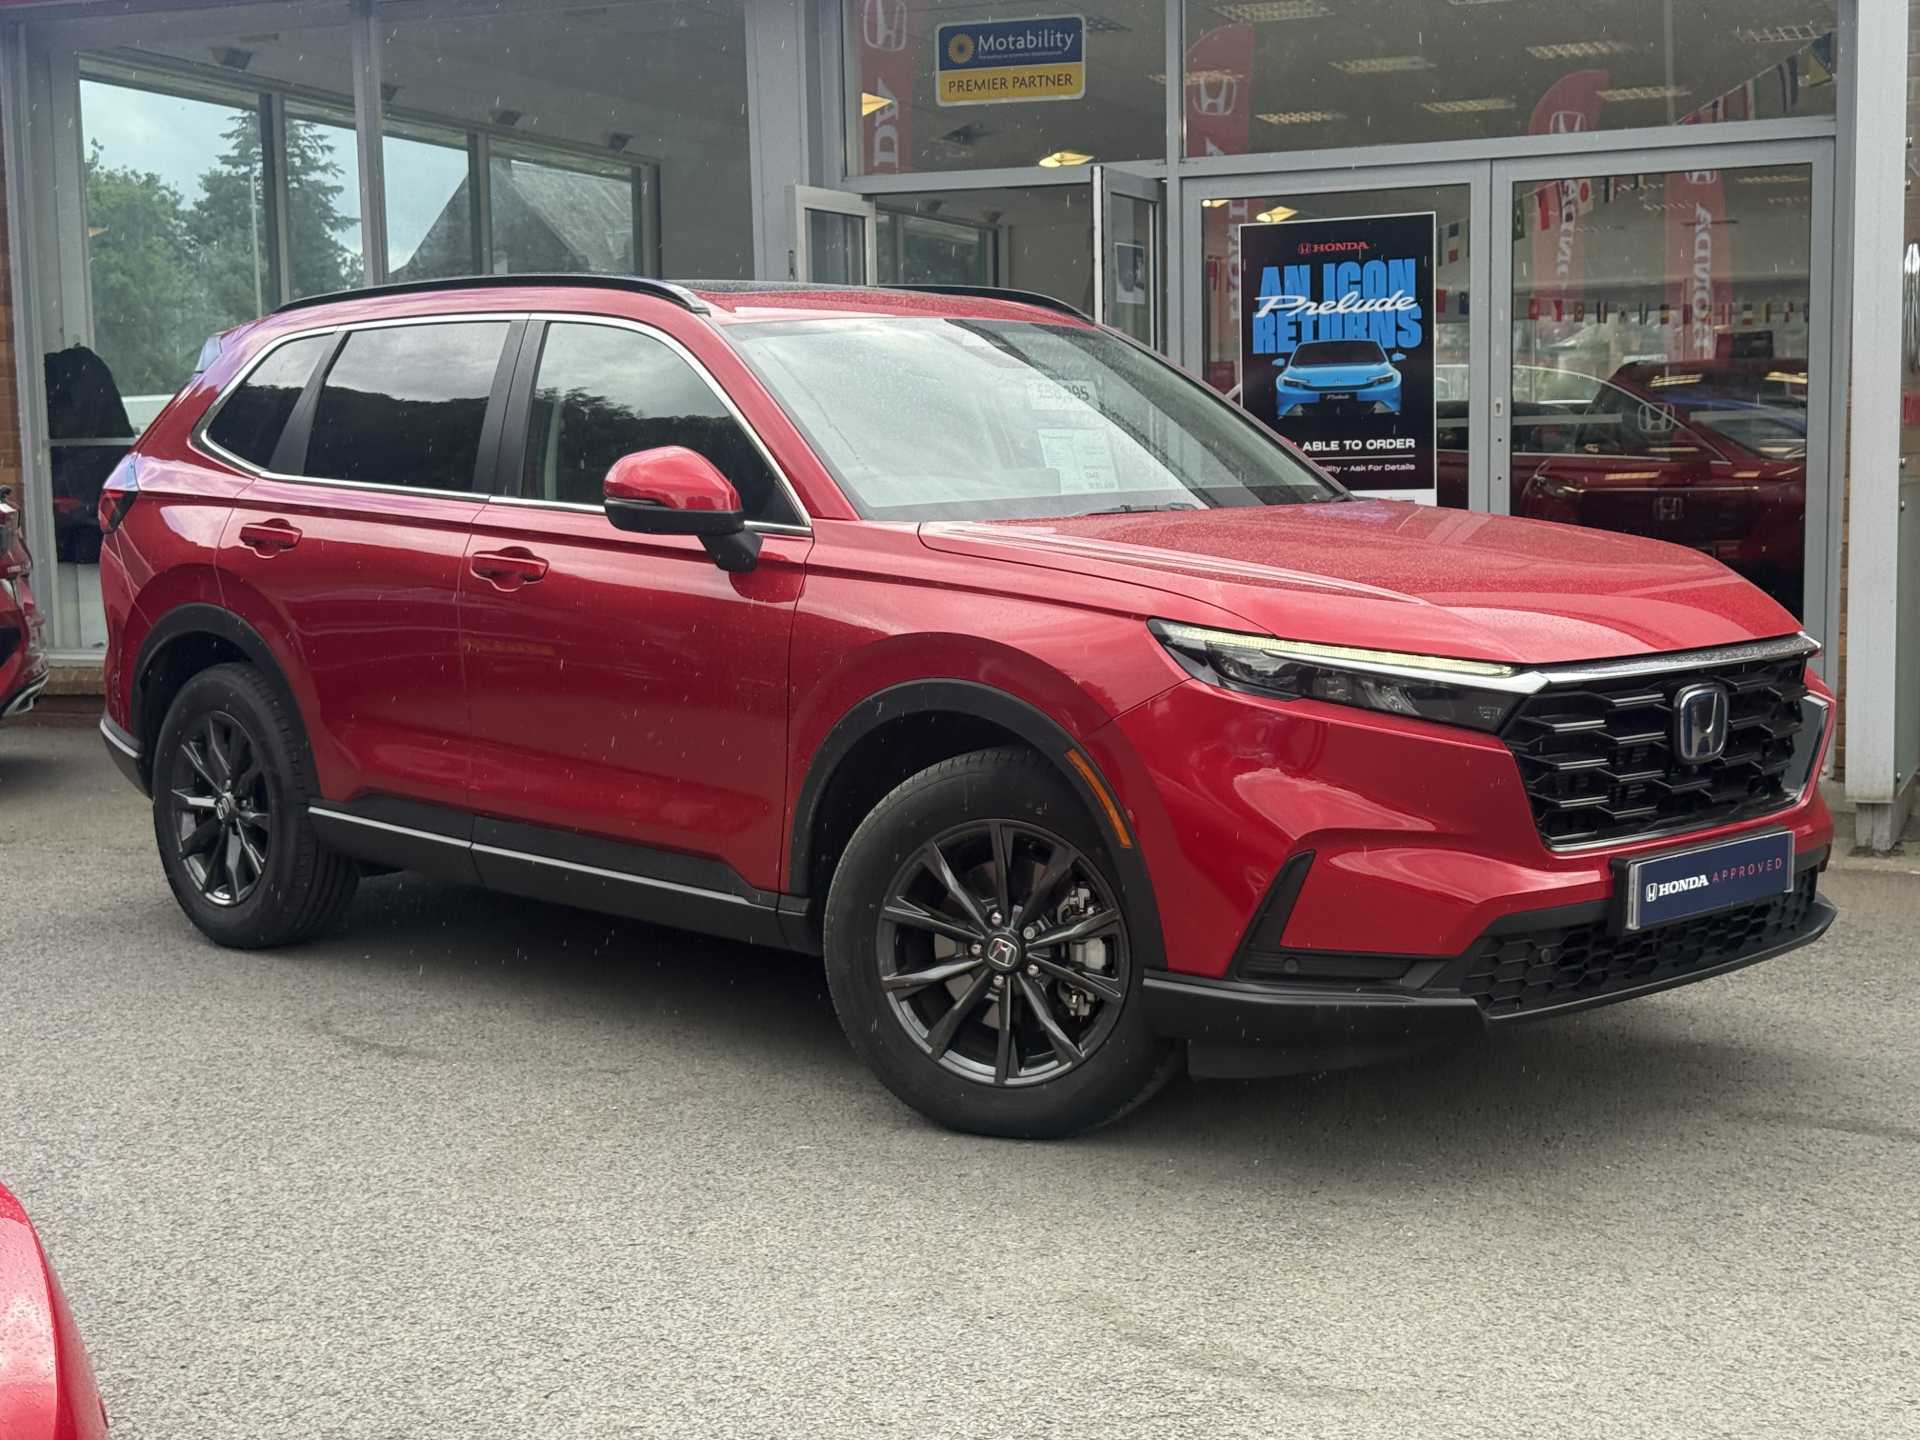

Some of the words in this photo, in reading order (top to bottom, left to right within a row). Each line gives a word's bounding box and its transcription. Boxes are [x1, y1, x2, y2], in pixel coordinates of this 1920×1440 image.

[978, 28, 1074, 52] Motability
[948, 77, 1009, 93] PREMIER
[1012, 73, 1073, 89] PARTNER
[1313, 241, 1370, 253] HONDA
[1258, 264, 1311, 310] AN
[1323, 257, 1417, 305] ICON
[1254, 289, 1419, 319] Prelude
[1252, 303, 1423, 354] RETURNS
[1294, 440, 1340, 452] ABLE
[1343, 440, 1363, 451] TO
[1366, 438, 1416, 450] ORDER
[1349, 464, 1367, 472] Ask
[1367, 464, 1384, 472] For
[1384, 462, 1416, 472] Details
[1658, 874, 1709, 897] HONDA
[1711, 857, 1783, 883] APPROVED
